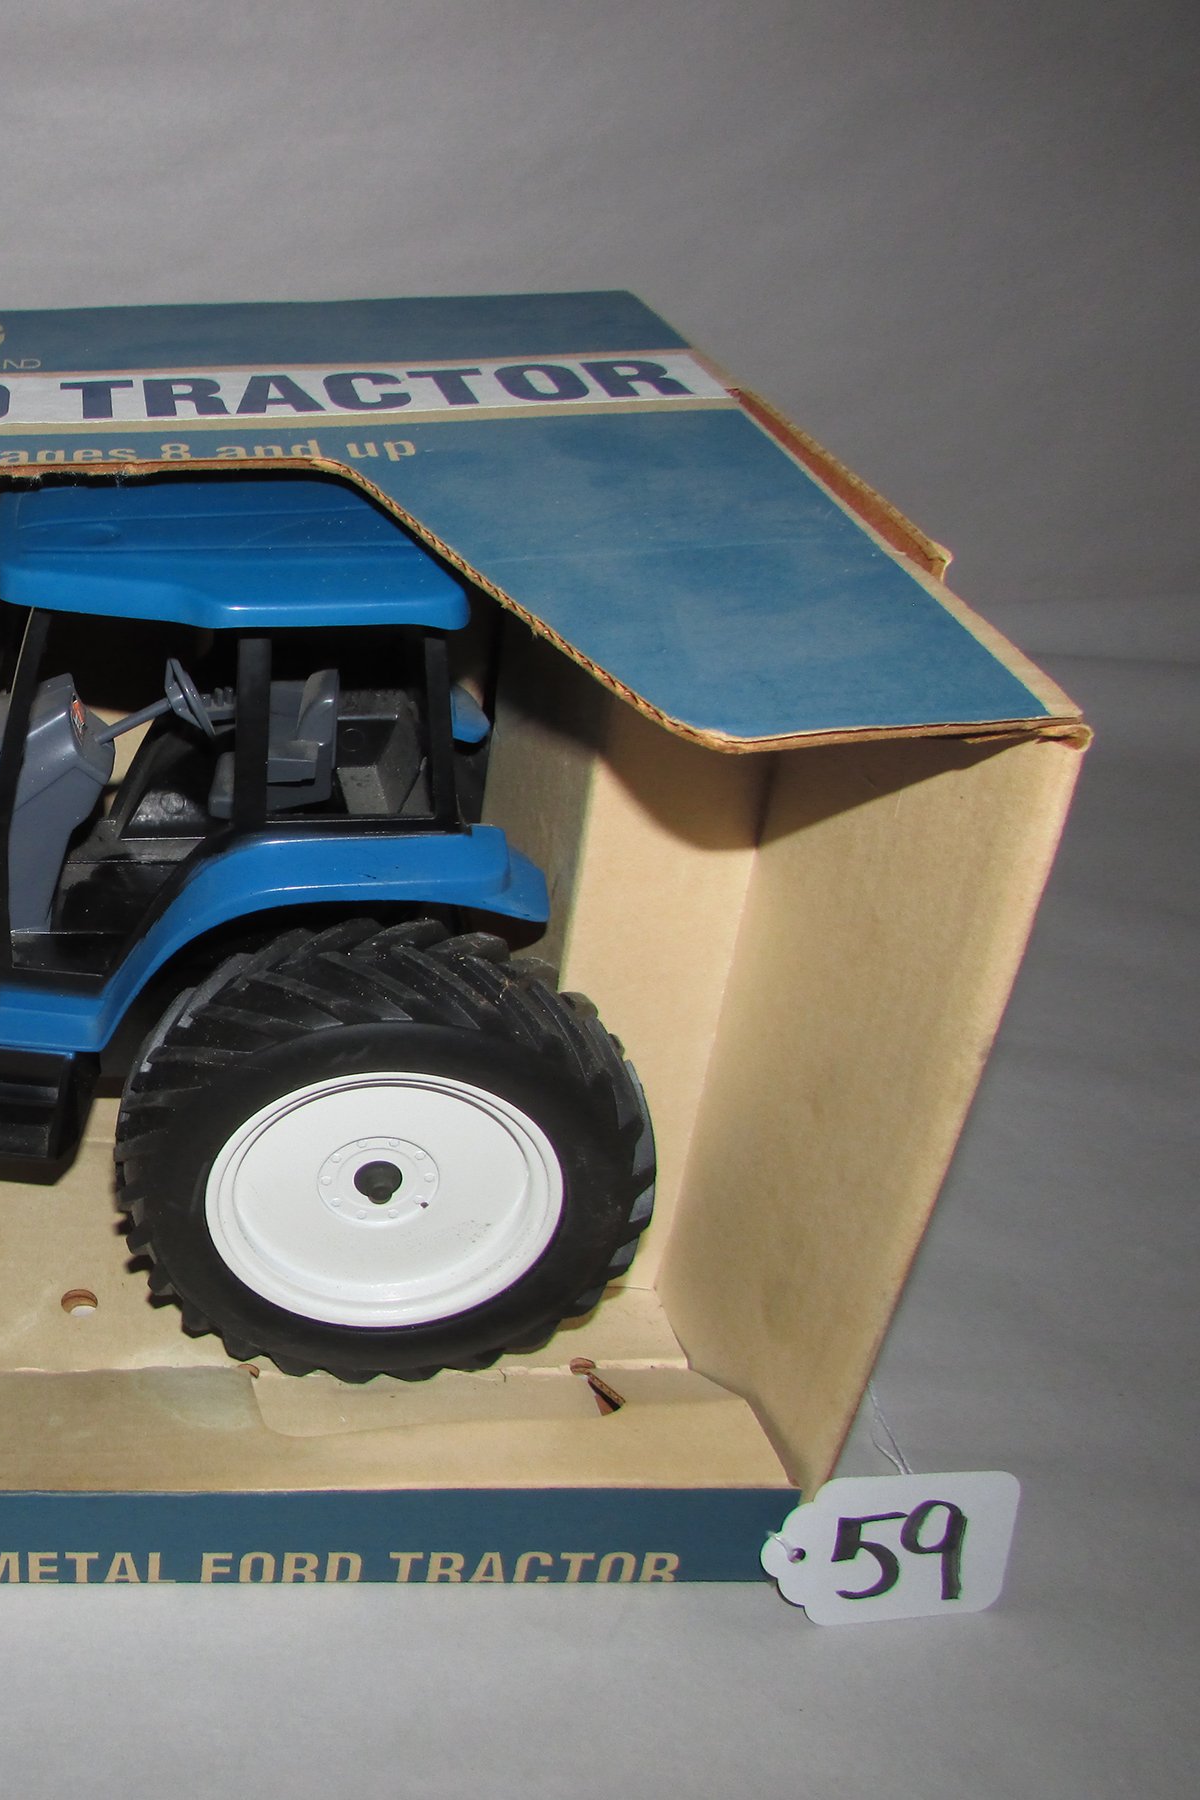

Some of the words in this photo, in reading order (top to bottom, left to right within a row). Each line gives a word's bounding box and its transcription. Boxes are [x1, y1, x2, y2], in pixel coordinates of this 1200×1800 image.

[60, 360, 695, 419] TRACTOR
[160, 444, 191, 461] 8
[216, 440, 321, 459] and
[346, 439, 416, 462] up
[200, 1551, 363, 1583] FORD
[389, 1551, 680, 1582] TRACTOR
[830, 1500, 968, 1600] 59
